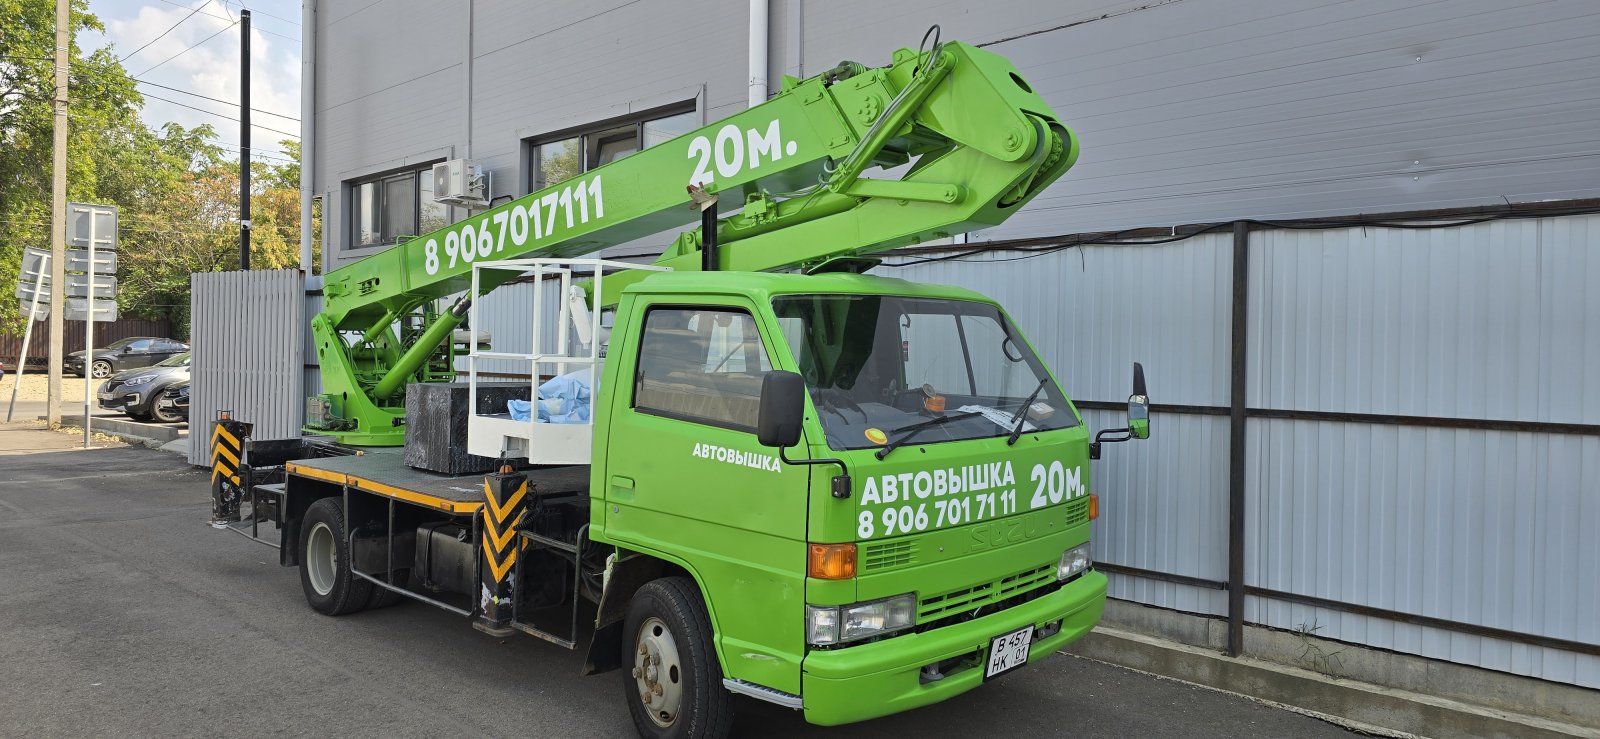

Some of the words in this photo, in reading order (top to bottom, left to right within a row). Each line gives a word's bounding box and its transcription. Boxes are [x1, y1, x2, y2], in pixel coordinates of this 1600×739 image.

[424, 238, 440, 276] 8
[444, 173, 604, 269] 9067017111
[692, 442, 782, 473] АВТОВЫШКА
[859, 460, 1016, 506] АВТОВЫШКА
[857, 510, 875, 539] 8
[881, 503, 930, 536] 906
[934, 496, 971, 528] 701
[975, 489, 995, 520] 71
[1000, 487, 1017, 515] 11
[1008, 629, 1028, 648] 457
[1015, 646, 1026, 660] 01
